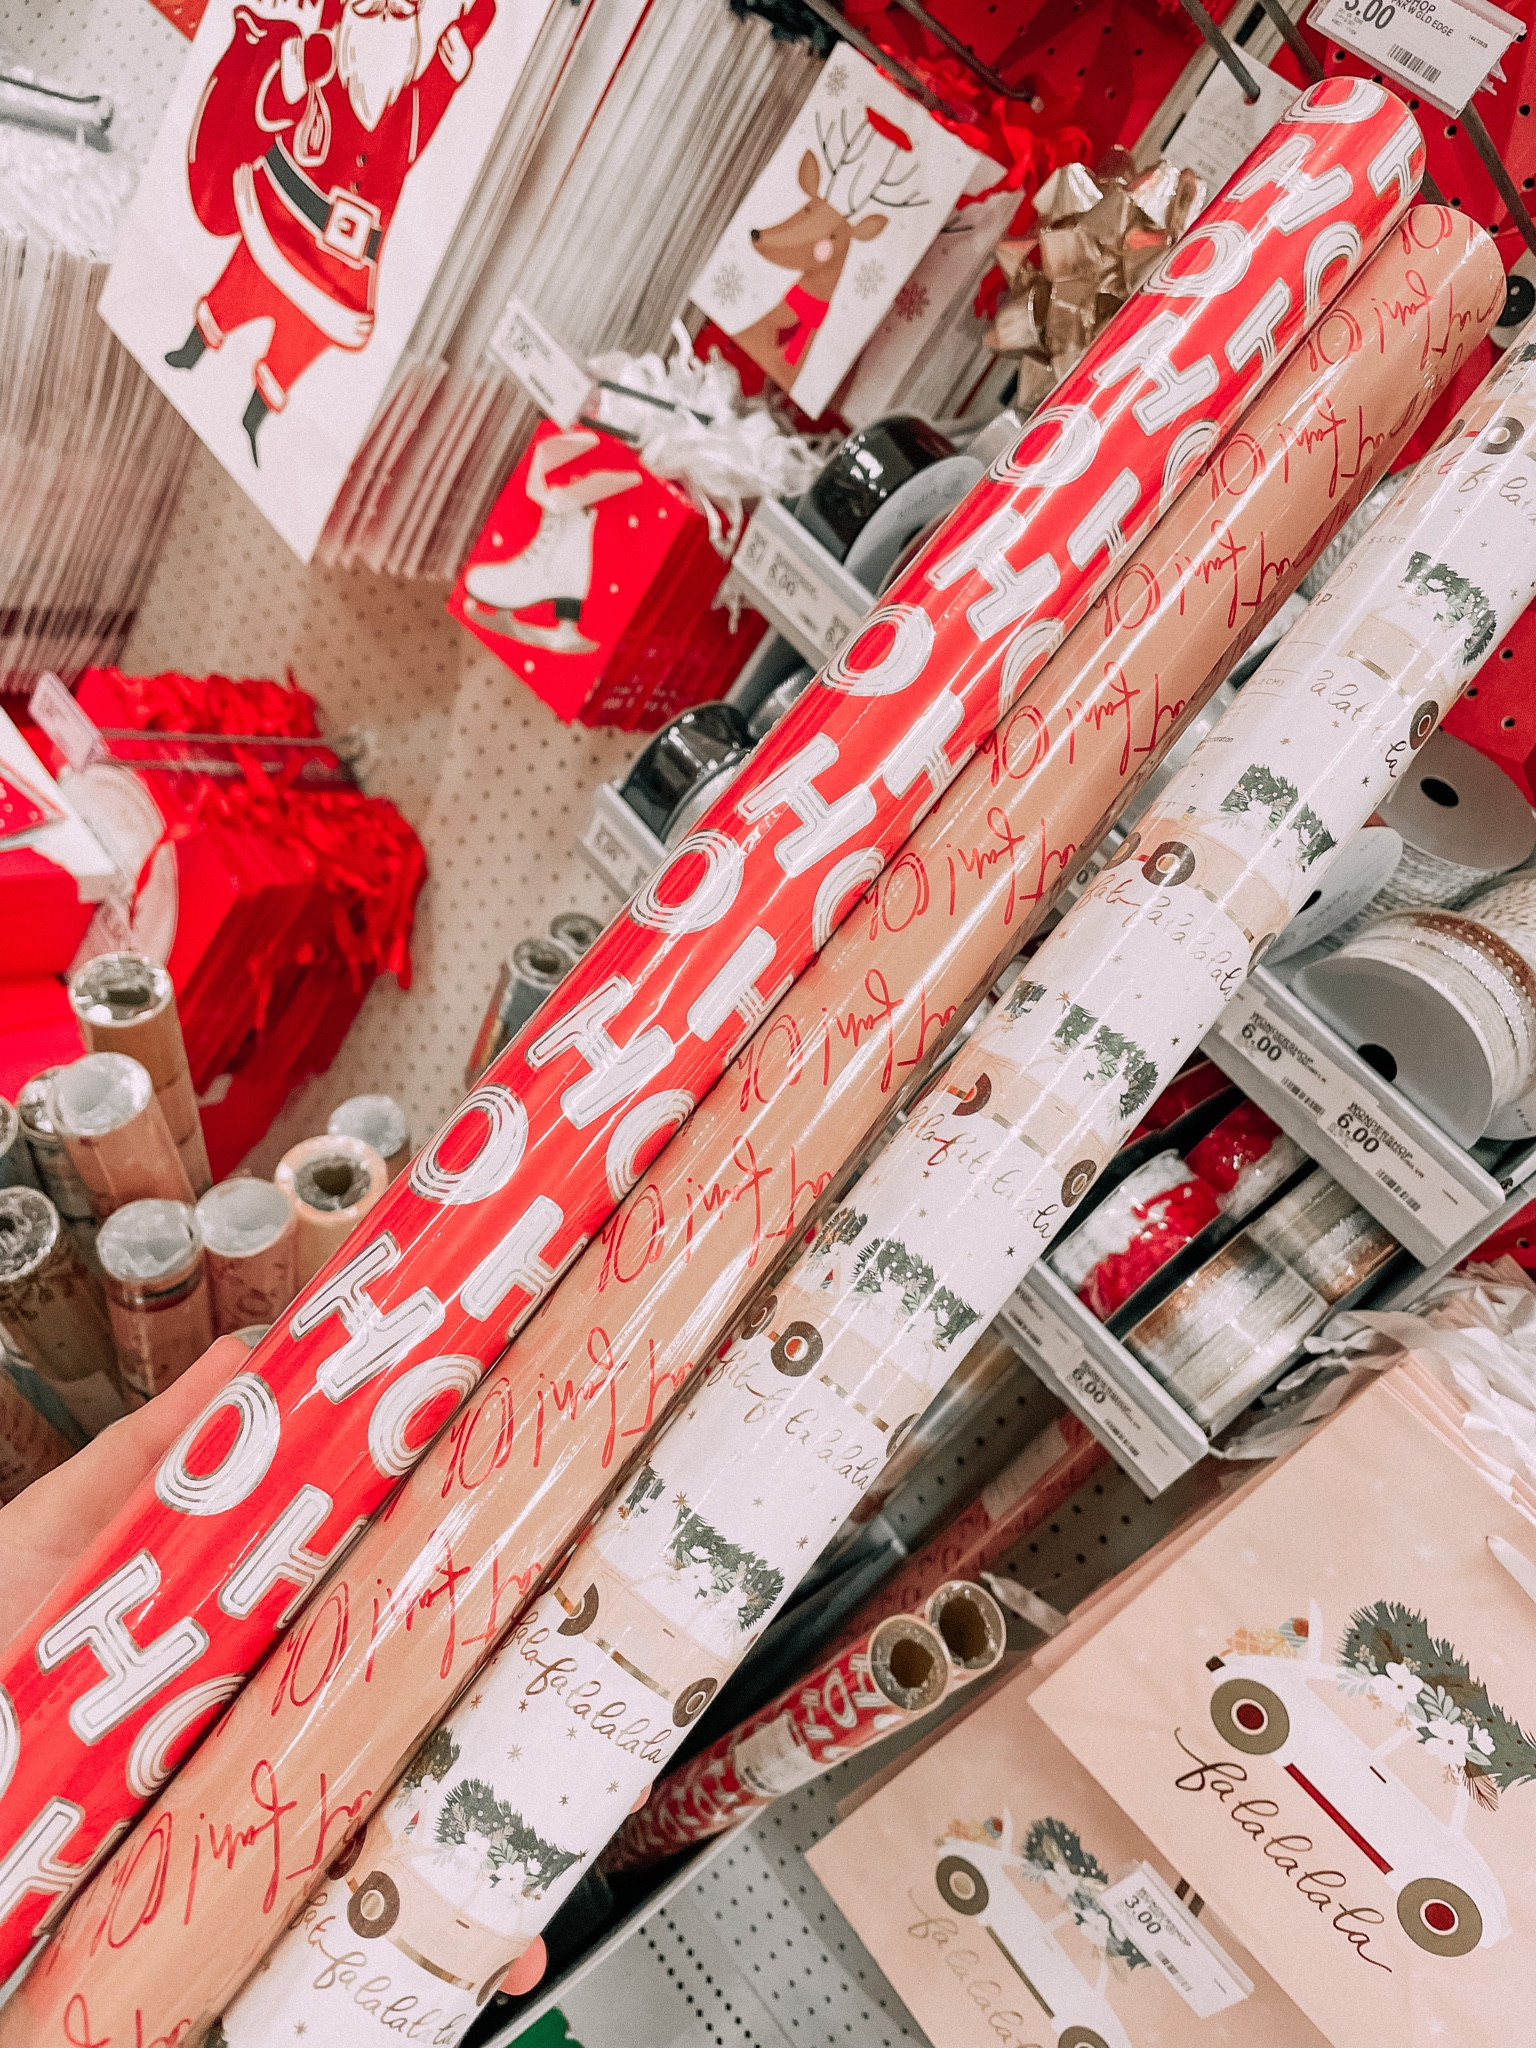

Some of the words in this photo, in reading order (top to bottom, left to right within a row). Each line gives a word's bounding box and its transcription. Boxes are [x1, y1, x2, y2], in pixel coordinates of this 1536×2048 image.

[1415, 9, 1432, 24] GLD
[1431, 19, 1453, 36] EDGE
[1241, 1023, 1280, 1062] 6.00
[1251, 1010, 1314, 1064] WONDERSHOP
[1336, 1112, 1377, 1154] 6.00
[1349, 1100, 1414, 1158] WONDERSHOP
[1071, 1368, 1105, 1403] 6.00
[1123, 1893, 1162, 1935] 3.00
